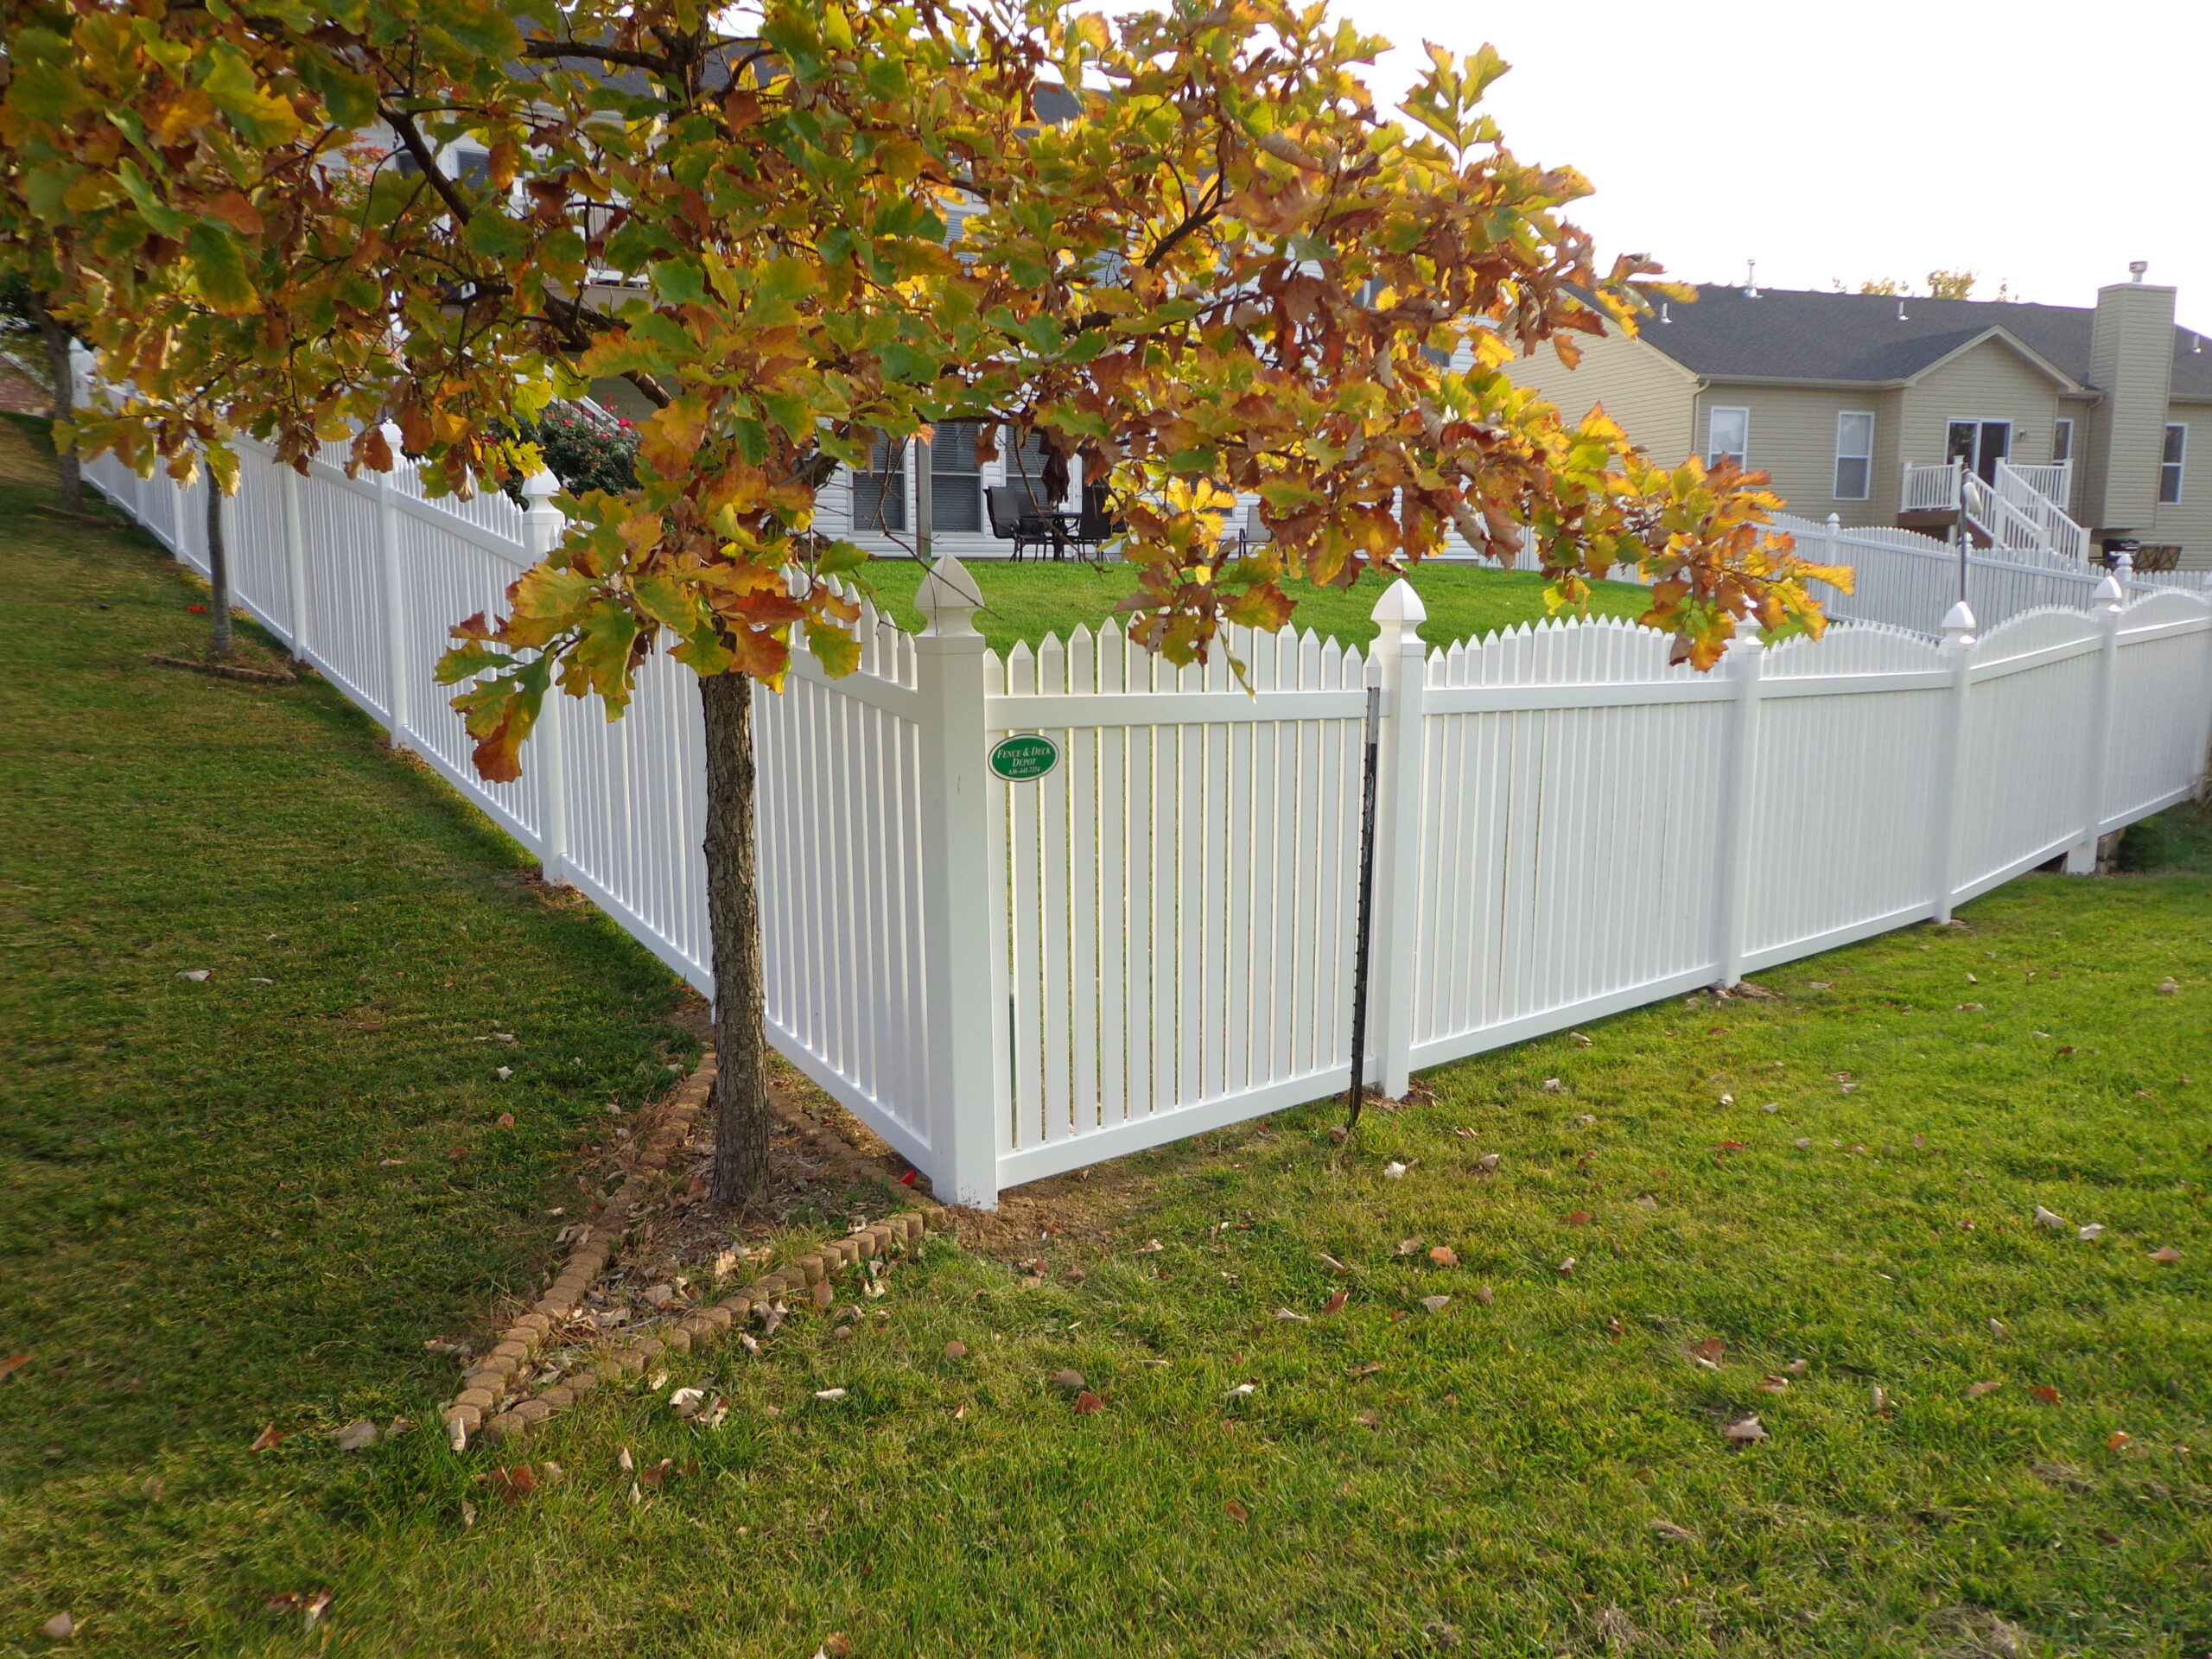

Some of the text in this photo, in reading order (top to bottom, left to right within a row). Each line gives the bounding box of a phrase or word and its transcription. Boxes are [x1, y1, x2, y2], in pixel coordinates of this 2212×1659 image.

[997, 747, 1051, 759] FENCE & DECK
[1012, 758, 1037, 766] DEPOT
